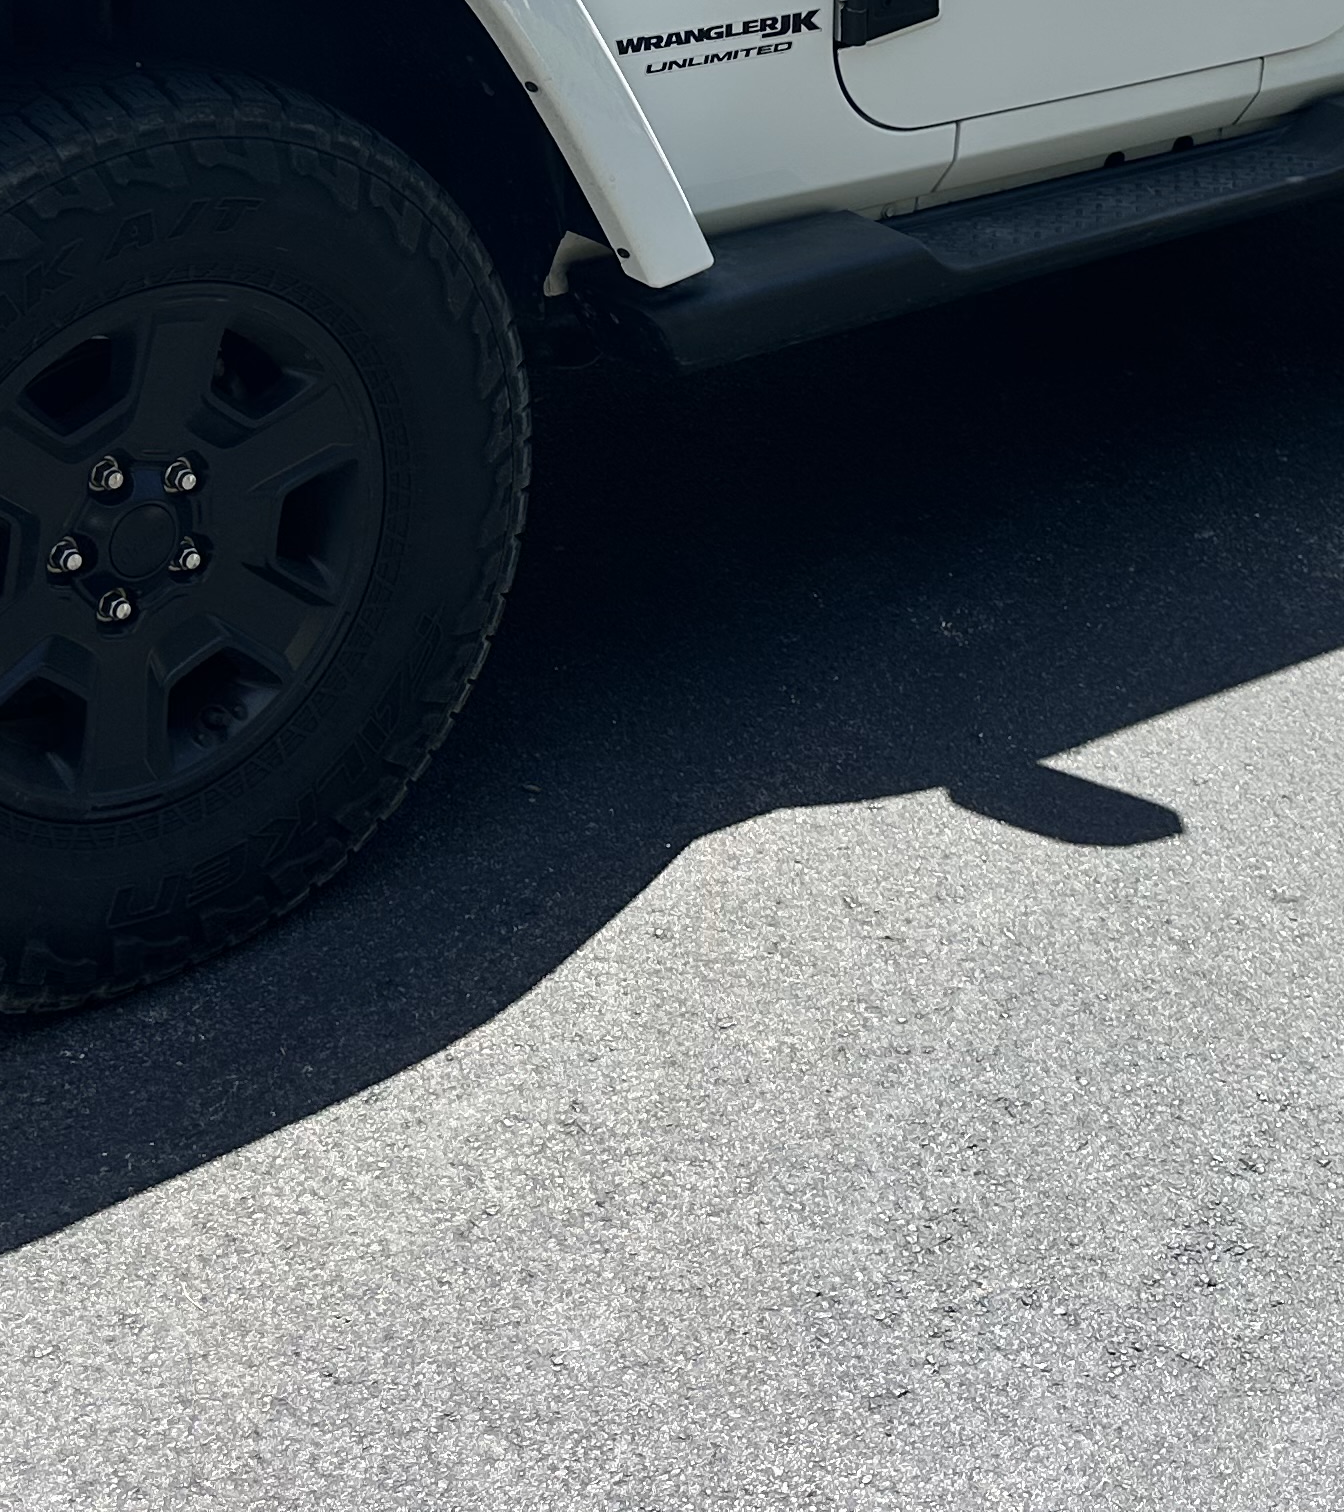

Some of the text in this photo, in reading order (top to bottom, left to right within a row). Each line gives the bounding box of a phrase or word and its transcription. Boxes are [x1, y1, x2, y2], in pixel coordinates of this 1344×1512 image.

[646, 41, 793, 74] UNLIMITED
[104, 196, 266, 263] A/T
[106, 609, 446, 931] FALKEN
